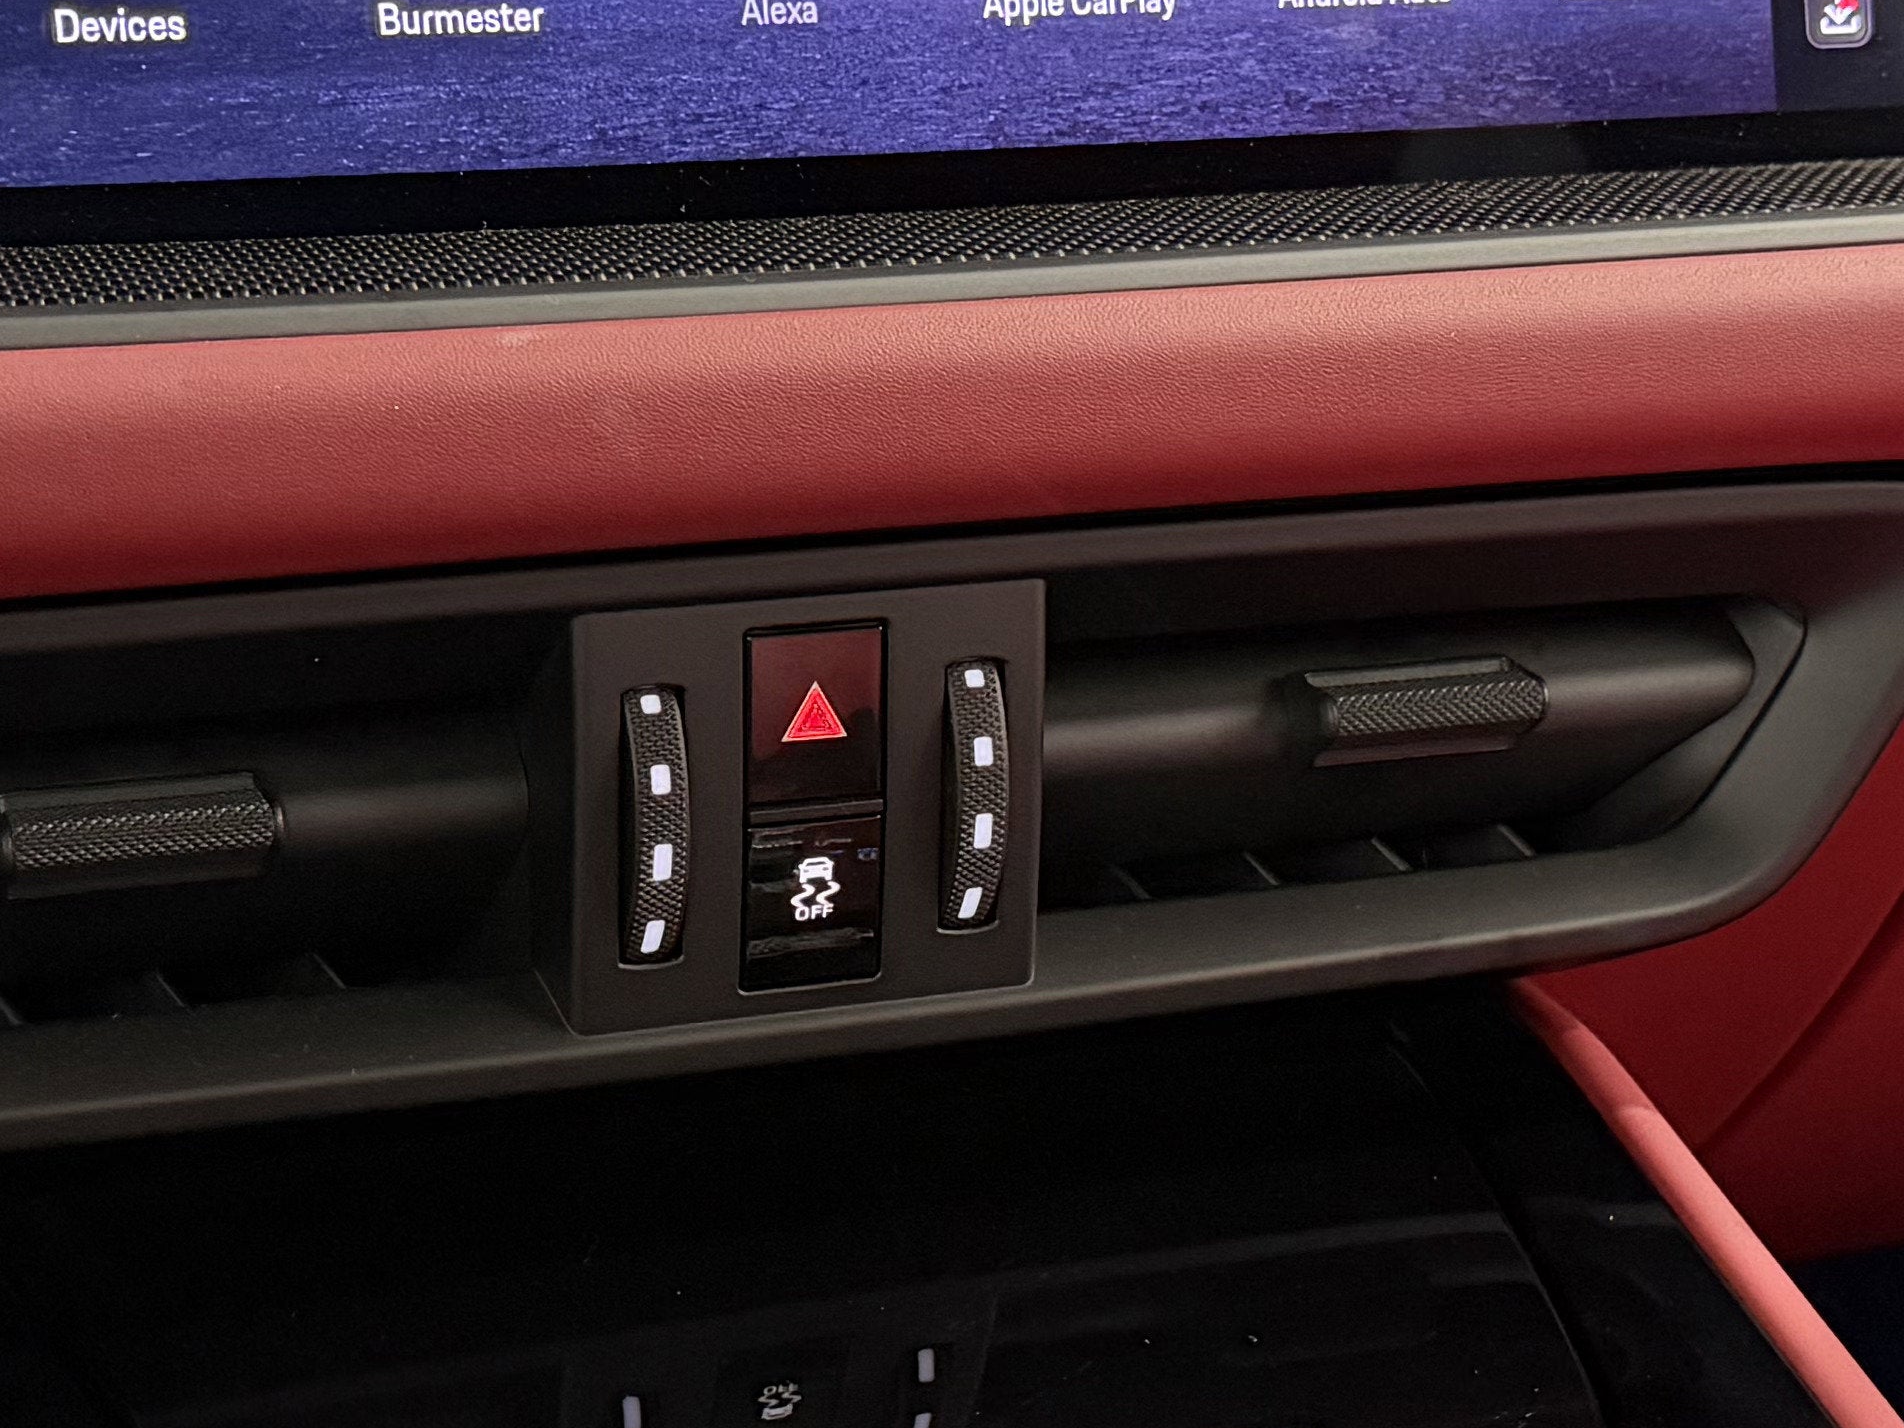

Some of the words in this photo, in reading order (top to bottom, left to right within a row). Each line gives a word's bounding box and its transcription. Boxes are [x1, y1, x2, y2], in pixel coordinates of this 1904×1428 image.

[54, 7, 187, 44] Devices
[378, 2, 545, 36] Burmester
[794, 903, 834, 921] OFF
